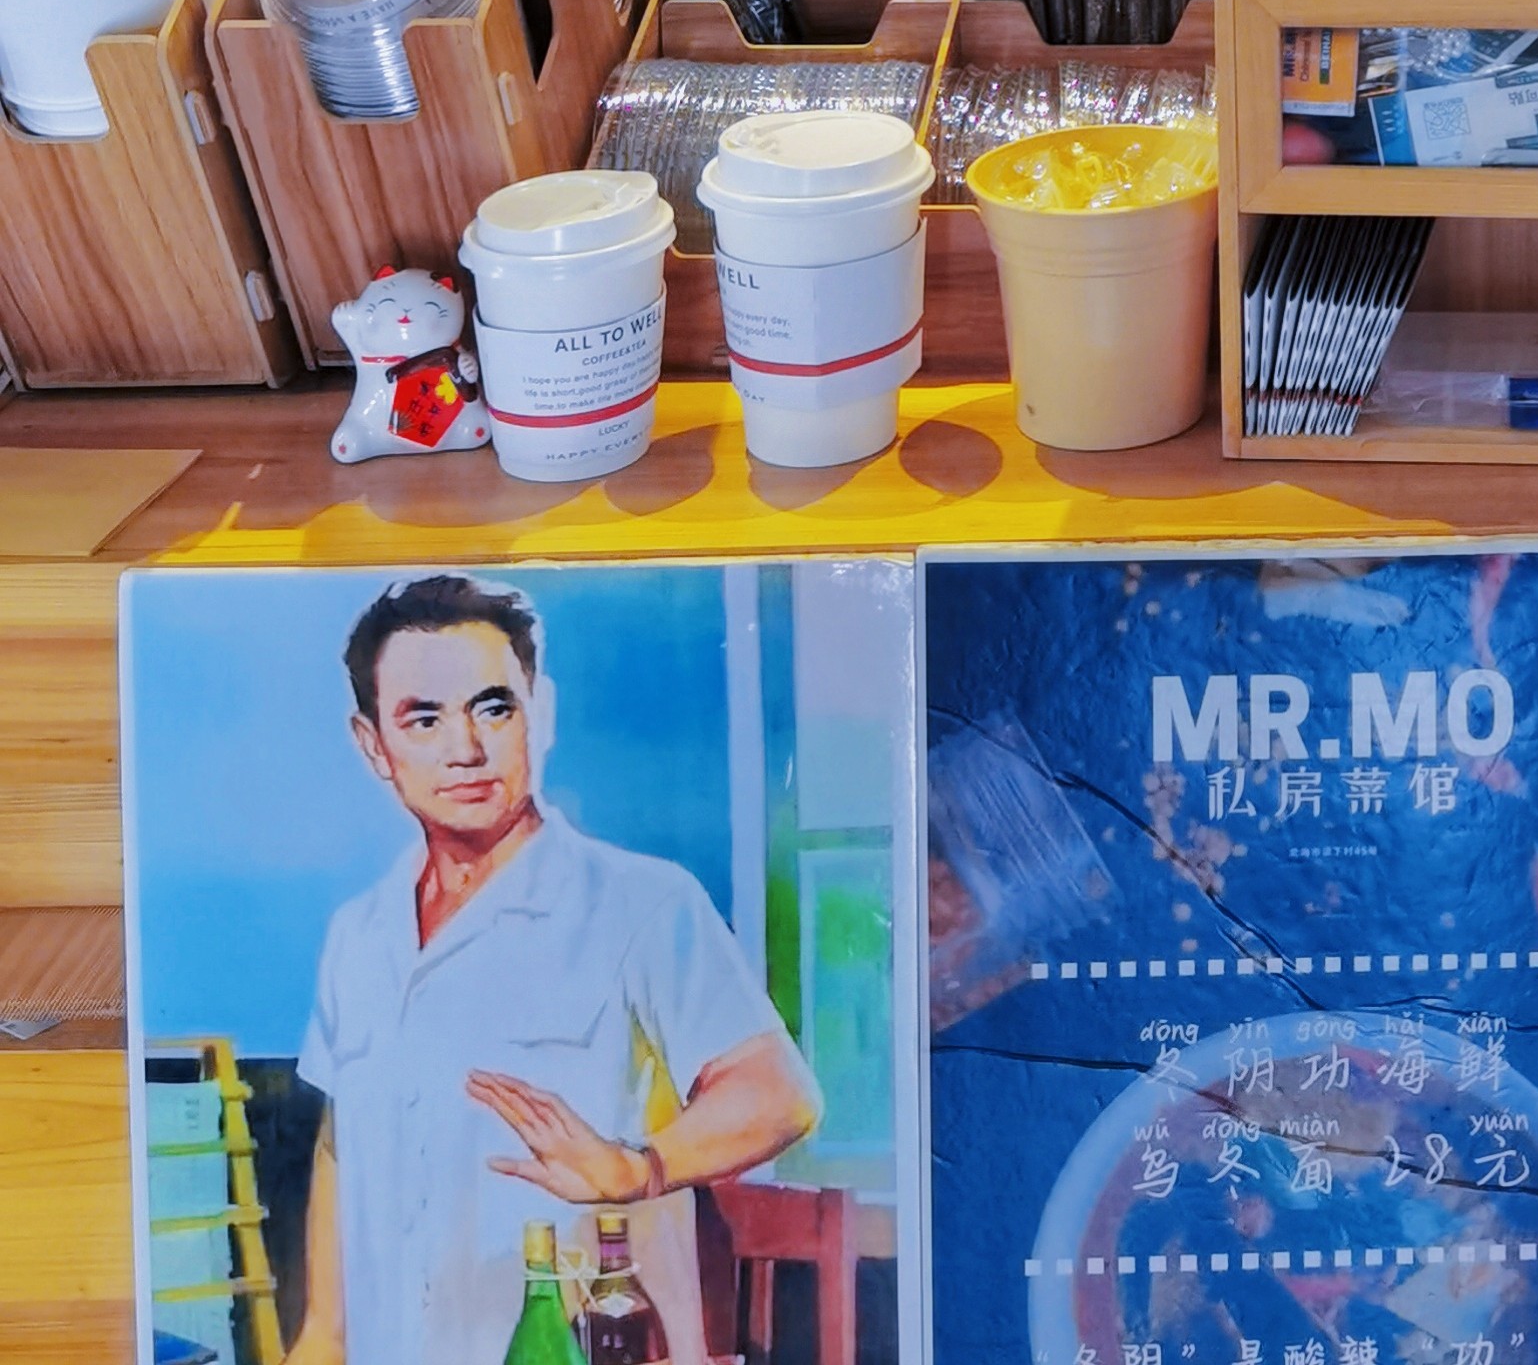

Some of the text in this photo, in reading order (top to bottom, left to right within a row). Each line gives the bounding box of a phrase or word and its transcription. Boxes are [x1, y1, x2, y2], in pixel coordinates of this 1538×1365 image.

[554, 308, 663, 353] ALL TO WELL
[599, 420, 631, 437] LUCKY
[1151, 668, 1514, 762] MR.MO
[1206, 762, 1460, 820] 私房菜馆
[1142, 1039, 1510, 1105] 冬阴功海鲜
[1131, 1141, 1335, 1200] 乌冬面
